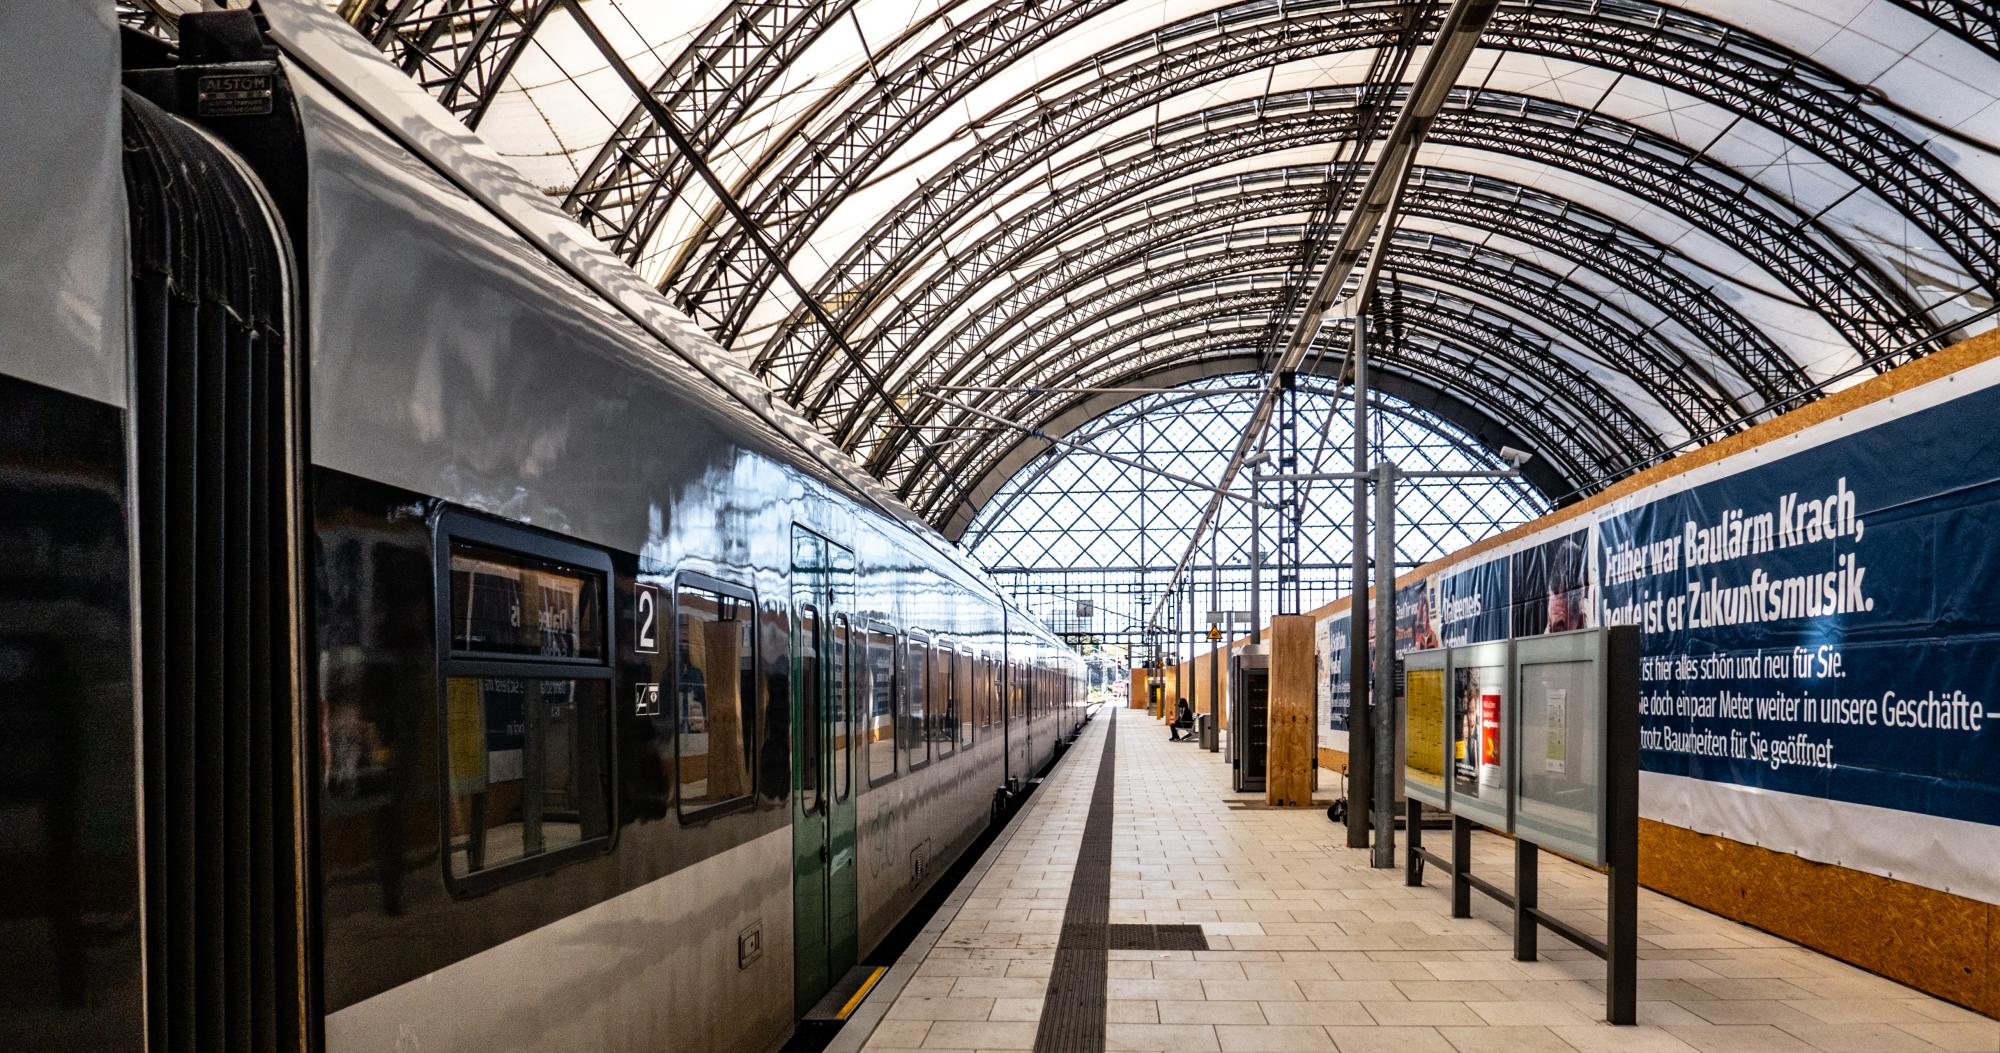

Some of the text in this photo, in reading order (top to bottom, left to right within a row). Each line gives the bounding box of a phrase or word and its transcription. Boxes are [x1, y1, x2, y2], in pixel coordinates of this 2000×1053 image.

[207, 78, 265, 91] ALSTOM
[1604, 476, 1864, 587] Früher war Baulärm Krach,
[1644, 590, 1664, 634] ist
[1667, 595, 1685, 632] er
[1689, 552, 1874, 629] Zukunftsmusik.
[639, 590, 654, 648] 2
[1642, 656, 1653, 681] ist
[1655, 656, 1672, 680] hier
[1675, 653, 1698, 680] alles
[1700, 652, 1734, 680] schön
[1736, 649, 1761, 680] und
[1764, 655, 1789, 679] neu
[1793, 646, 1814, 679] für
[1816, 645, 1846, 679] Sie.
[1651, 690, 1673, 716] doch
[1719, 690, 1754, 720] Meter
[1756, 690, 1800, 722] weiter
[1804, 690, 1817, 723] in
[1821, 698, 1878, 726] unsere
[1882, 690, 1983, 731] Geschäfte
[1640, 725, 1663, 750] trotz
[1731, 729, 1747, 759] für
[1750, 732, 1769, 762] Sie
